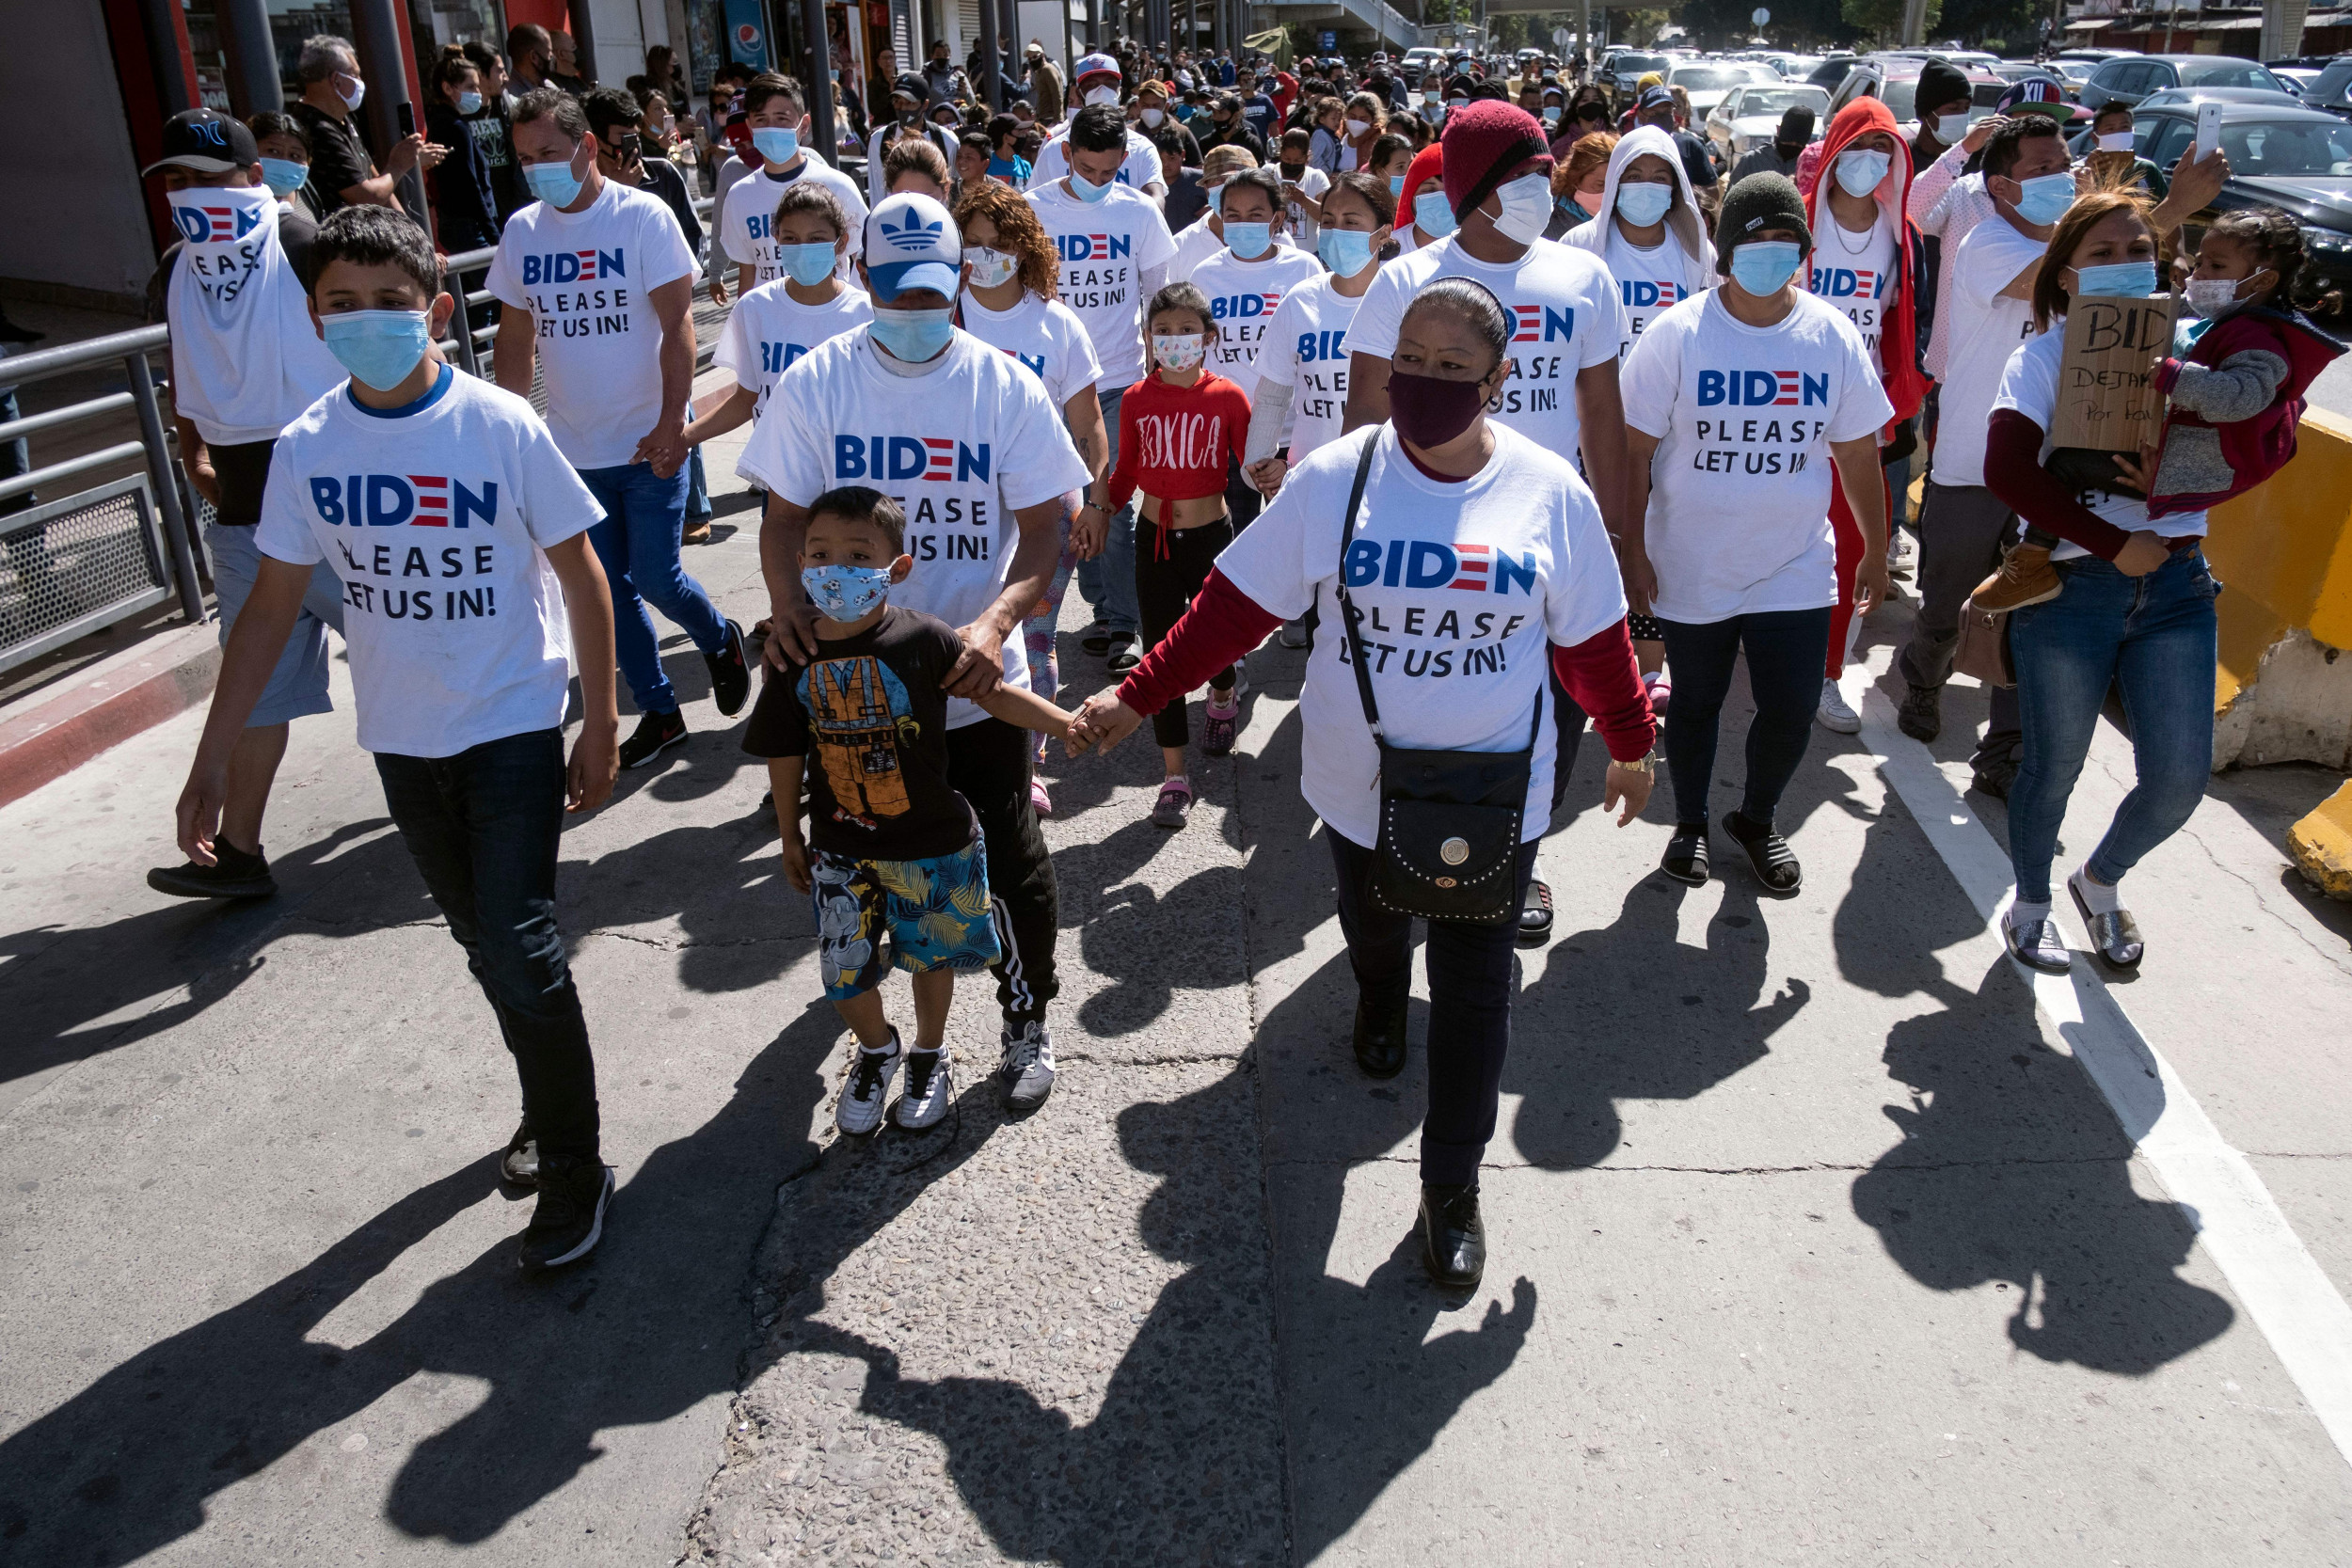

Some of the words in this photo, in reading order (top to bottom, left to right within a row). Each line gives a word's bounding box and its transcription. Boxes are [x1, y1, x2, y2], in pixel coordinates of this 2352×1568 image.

[173, 207, 262, 244] IDEN
[1052, 234, 1130, 261] IDEN
[523, 248, 626, 285] BIDEN
[1057, 268, 1127, 287] EASE
[526, 290, 628, 313] PLEASE
[1074, 293, 1099, 309] US
[1104, 288, 1126, 307] IN!
[1212, 293, 1280, 321] BIDE
[563, 318, 591, 338] US
[596, 314, 629, 335] IN!
[1223, 325, 1266, 342] LEA
[1304, 372, 1346, 391] PLE
[1505, 356, 1561, 381] ASE
[1531, 388, 1558, 412] IN!
[1697, 370, 1829, 408] BIDEN
[1136, 412, 1221, 469] TOXICA
[835, 435, 991, 484] BIDEN
[1694, 449, 1739, 472] LET
[1745, 452, 1782, 474] US
[310, 474, 498, 528] BIDEN
[947, 534, 989, 562] IN!
[1345, 539, 1536, 596] BIDEN
[383, 590, 434, 621] US
[446, 587, 497, 621] IN!
[1404, 649, 1453, 677] US
[1464, 642, 1506, 675] IN!
